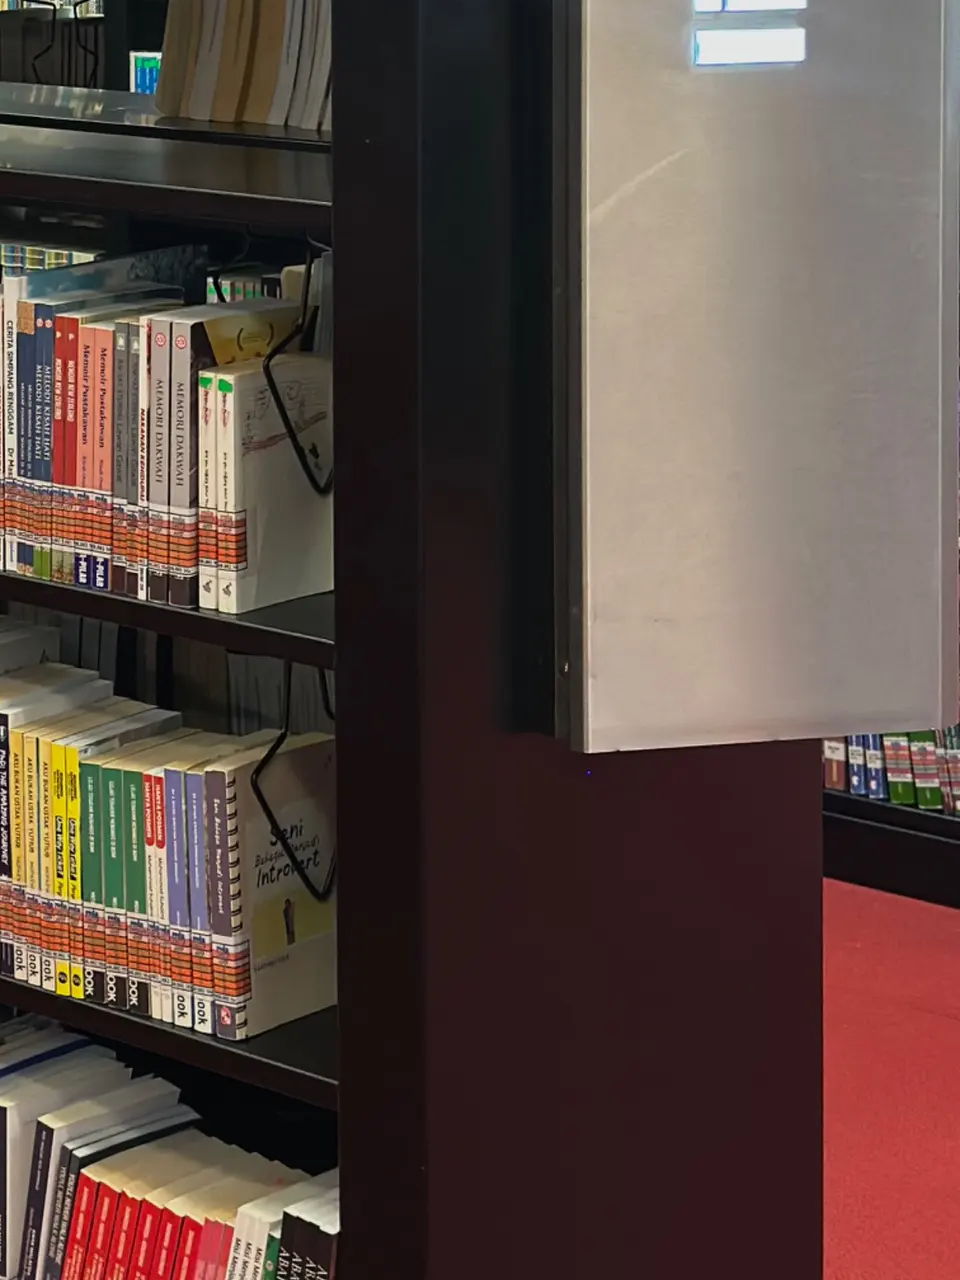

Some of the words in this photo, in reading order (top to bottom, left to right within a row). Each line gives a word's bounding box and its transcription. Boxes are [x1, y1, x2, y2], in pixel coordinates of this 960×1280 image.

[6, 320, 14, 349] CERITA
[6, 351, 14, 389] SIMPANG
[83, 344, 91, 382] Memoir
[100, 347, 108, 385] Memoir
[6, 391, 14, 434] RENGGAM
[82, 385, 90, 445] Pustakawan
[99, 388, 107, 448] Pustakawan
[156, 379, 164, 428] MEMORI
[176, 382, 185, 431] MEMORI
[156, 433, 164, 483] DAKWAH
[176, 435, 185, 486] DAKWAH
